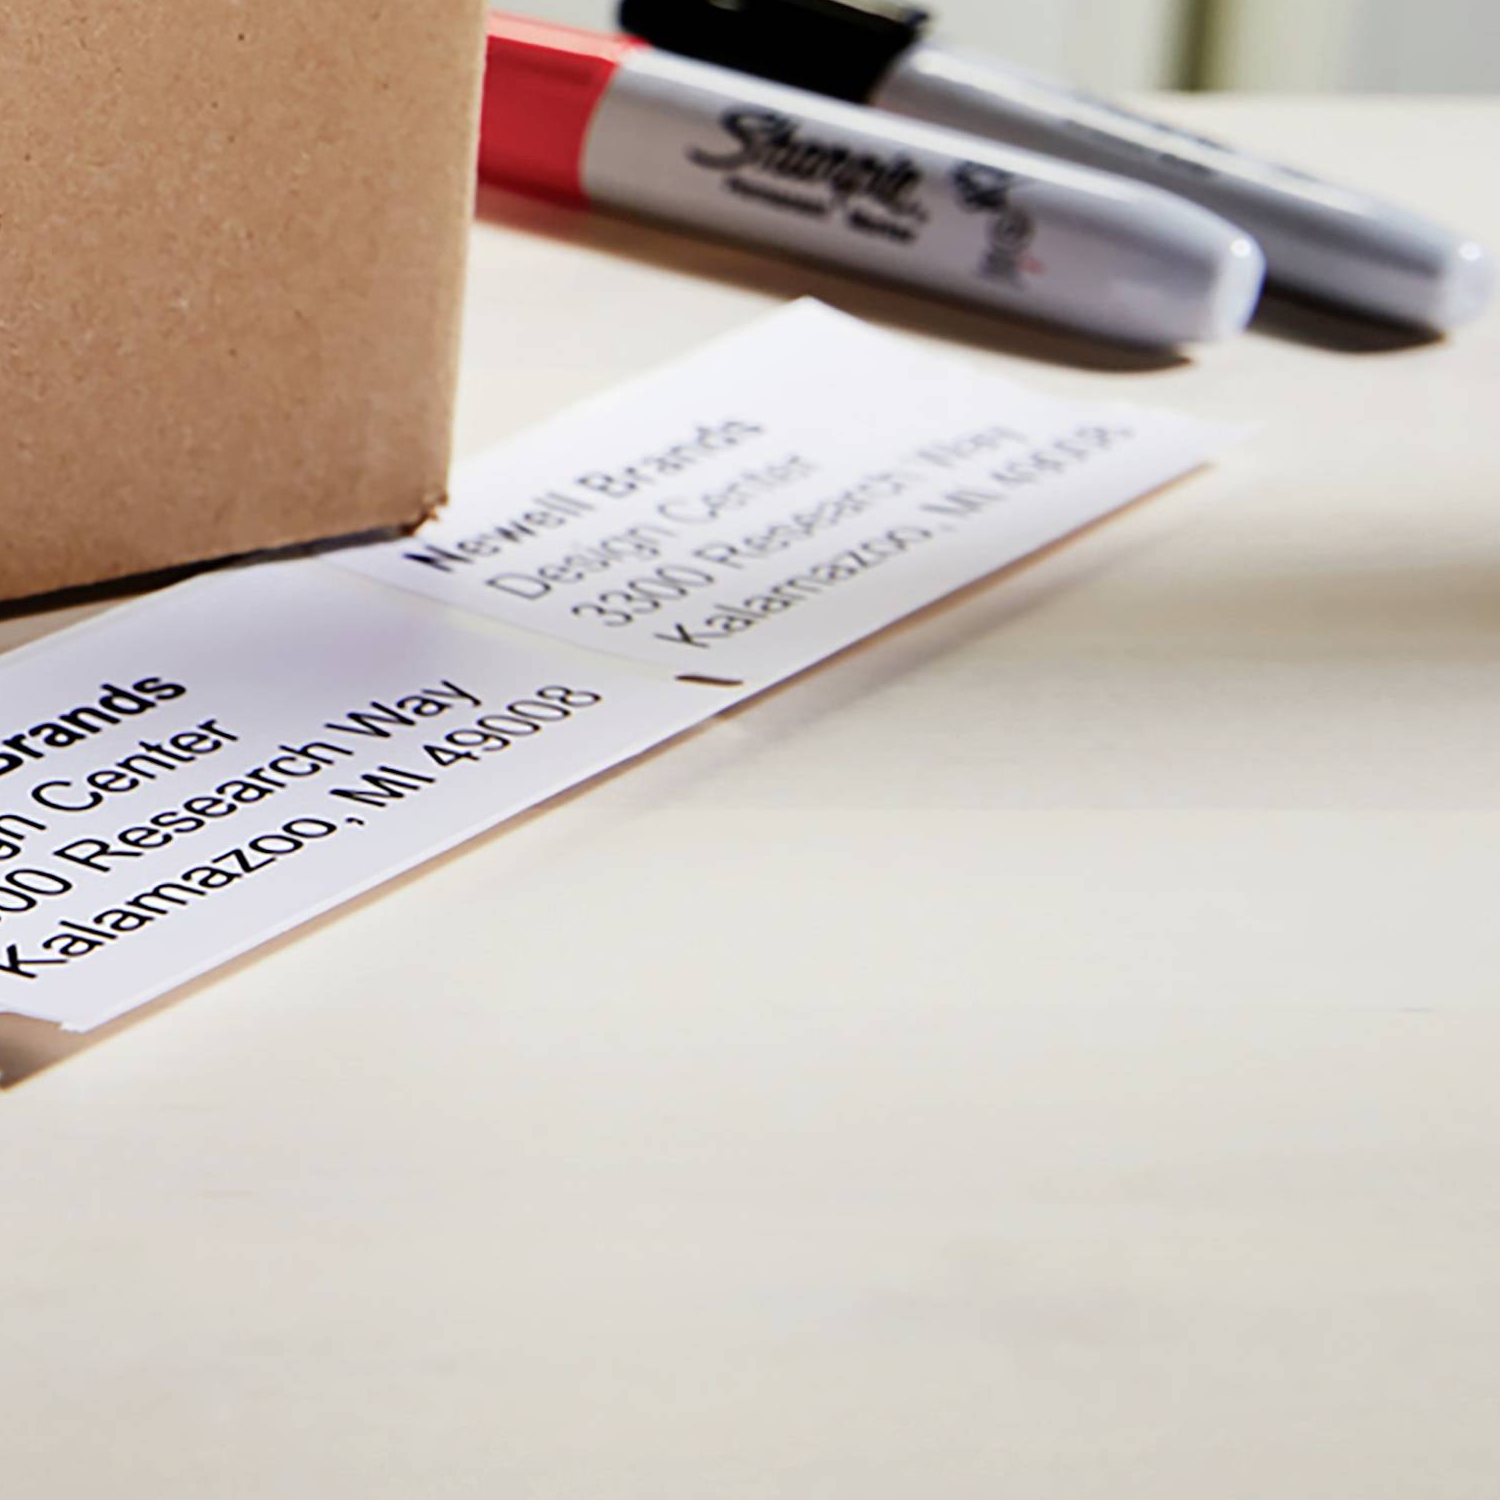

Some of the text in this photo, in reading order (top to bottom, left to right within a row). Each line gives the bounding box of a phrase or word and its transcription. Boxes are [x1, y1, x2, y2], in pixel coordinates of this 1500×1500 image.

[401, 420, 764, 573] Newell Brands
[484, 522, 678, 601] Design
[571, 566, 715, 627] 3300
[33, 719, 238, 812] Center
[52, 743, 354, 873] Research
[324, 680, 482, 740] Way
[328, 765, 436, 808] MI
[422, 685, 602, 768] 49008
